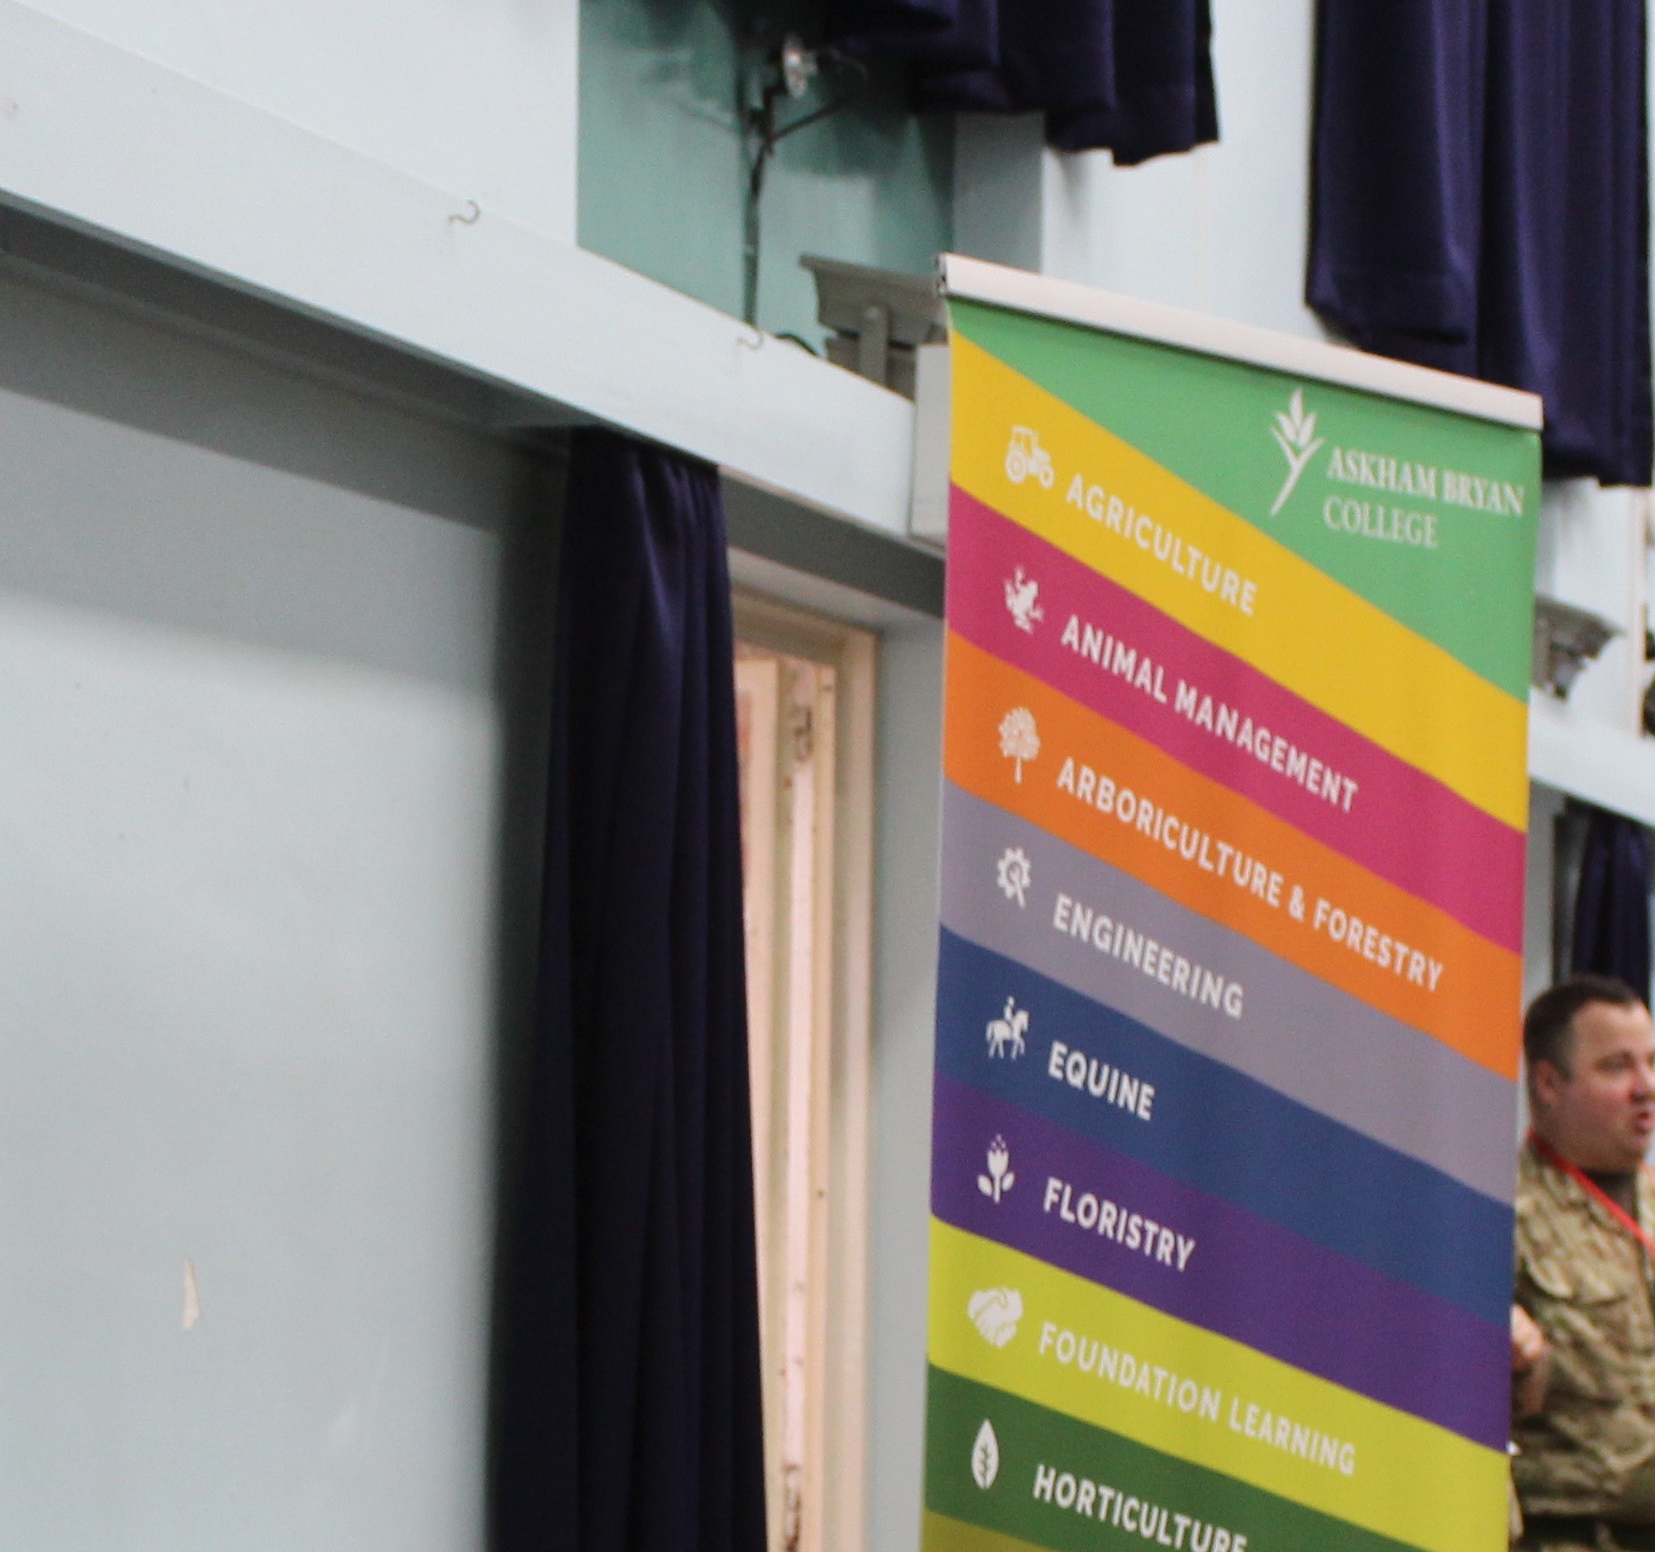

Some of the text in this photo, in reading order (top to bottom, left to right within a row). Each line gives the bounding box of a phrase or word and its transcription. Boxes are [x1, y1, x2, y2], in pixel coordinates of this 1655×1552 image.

[1065, 473, 1258, 615] AGRICULTURE
[1322, 495, 1438, 549] COLLEGE
[1327, 446, 1525, 516] ASKHAM BRYAN
[1060, 615, 1359, 813] ANIMAL MANAGEMENT
[1056, 757, 1444, 992] ARBORICULTURE & FORESTRY
[1052, 893, 1245, 1019] ENGINEERING
[1047, 1039, 1155, 1121] EQUINE
[1044, 1175, 1196, 1273] FLORISTRY
[1038, 1320, 1356, 1477] FOUNDATION LEARNING
